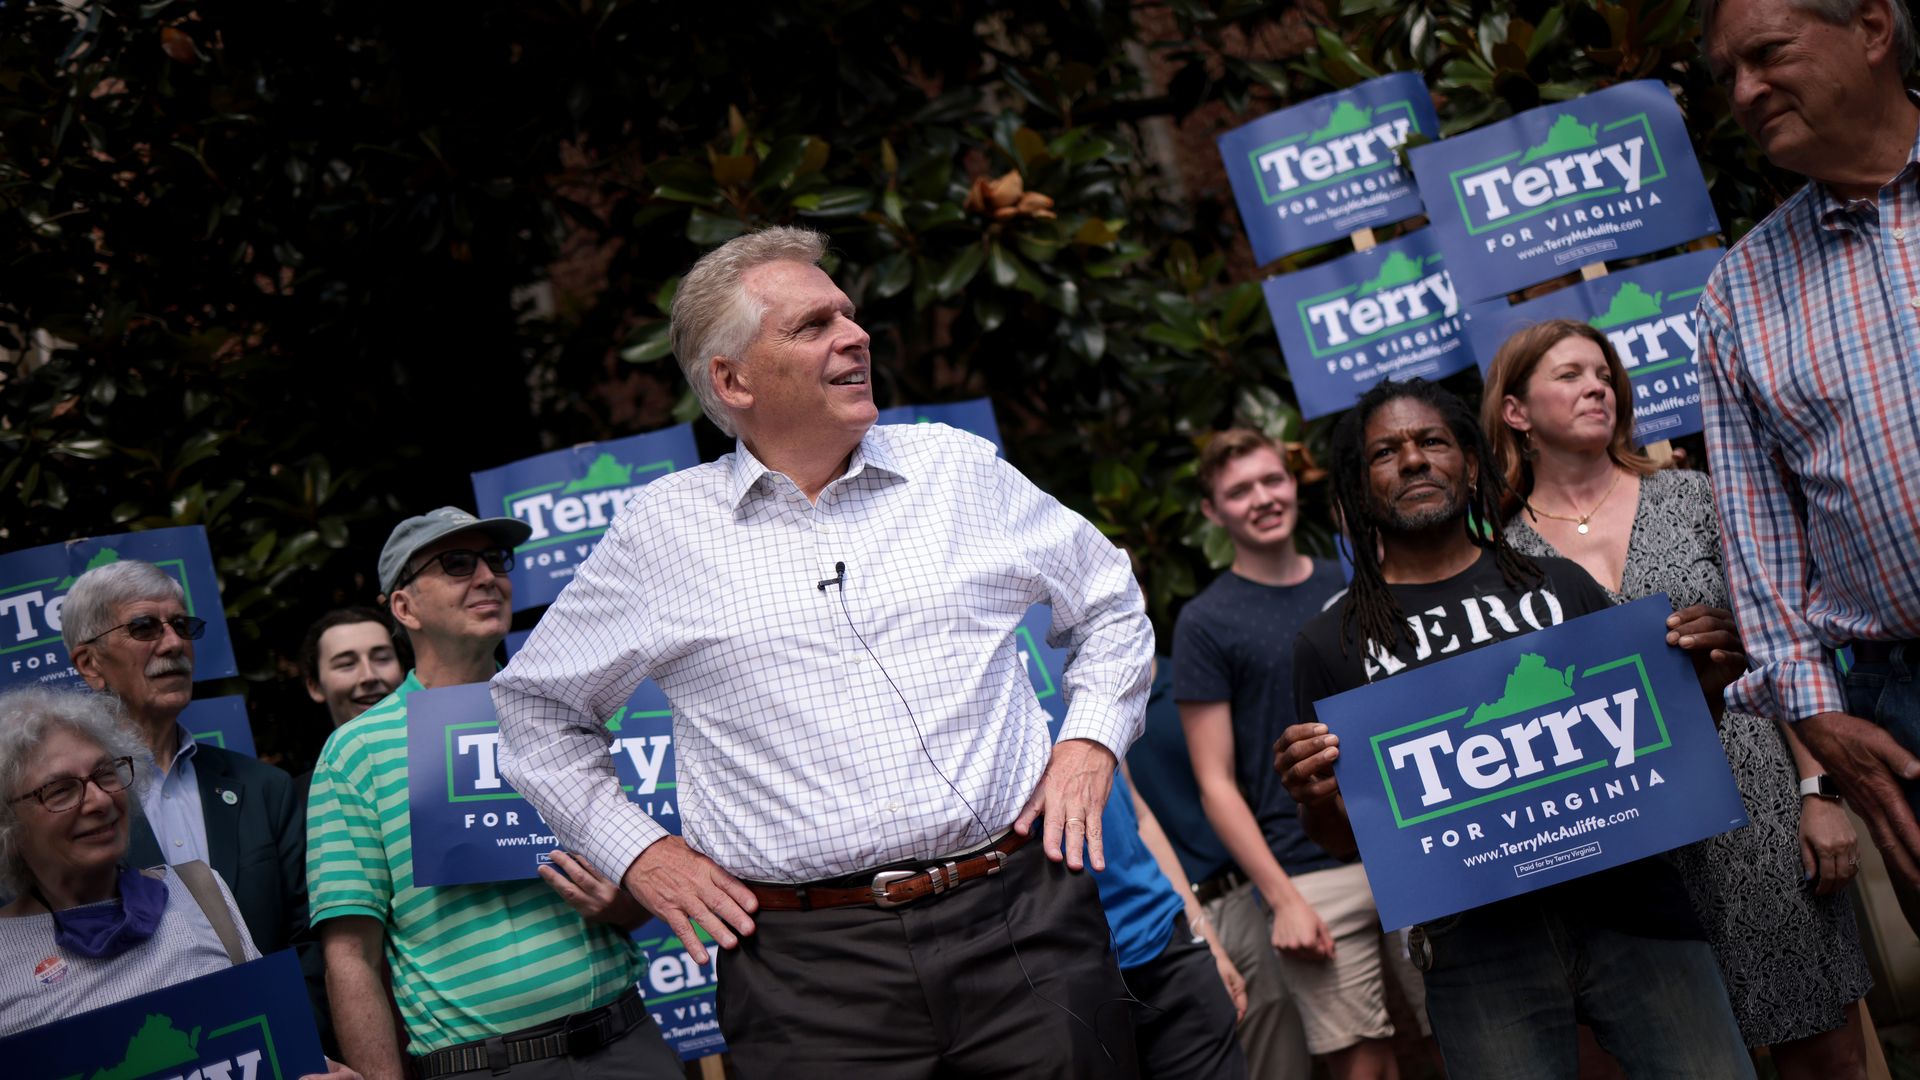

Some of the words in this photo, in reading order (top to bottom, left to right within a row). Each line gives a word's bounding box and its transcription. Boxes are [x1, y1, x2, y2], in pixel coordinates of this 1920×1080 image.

[1258, 117, 1410, 192] Terry
[1462, 136, 1644, 221] Terry
[1278, 197, 1318, 219] FOR
[1486, 227, 1534, 253] FOR
[1545, 192, 1662, 232] VIRGINIA
[1308, 269, 1458, 346] Terry
[1327, 352, 1368, 374] FOR
[1606, 310, 1698, 369] rry
[1636, 370, 1698, 399] RGIN
[512, 484, 648, 541] Terr
[525, 549, 566, 570] FOR
[12, 652, 58, 674] FOR
[1388, 687, 1639, 807] Terry
[464, 811, 520, 829] FOR
[1421, 822, 1485, 854] FOR
[1501, 768, 1665, 829] VIRGINIA
[1463, 807, 1640, 868] www.TerryMcAuliffe.com
[1519, 863, 1535, 873] Paid
[1554, 853, 1571, 862] Terry
[1571, 846, 1596, 857] Virginia
